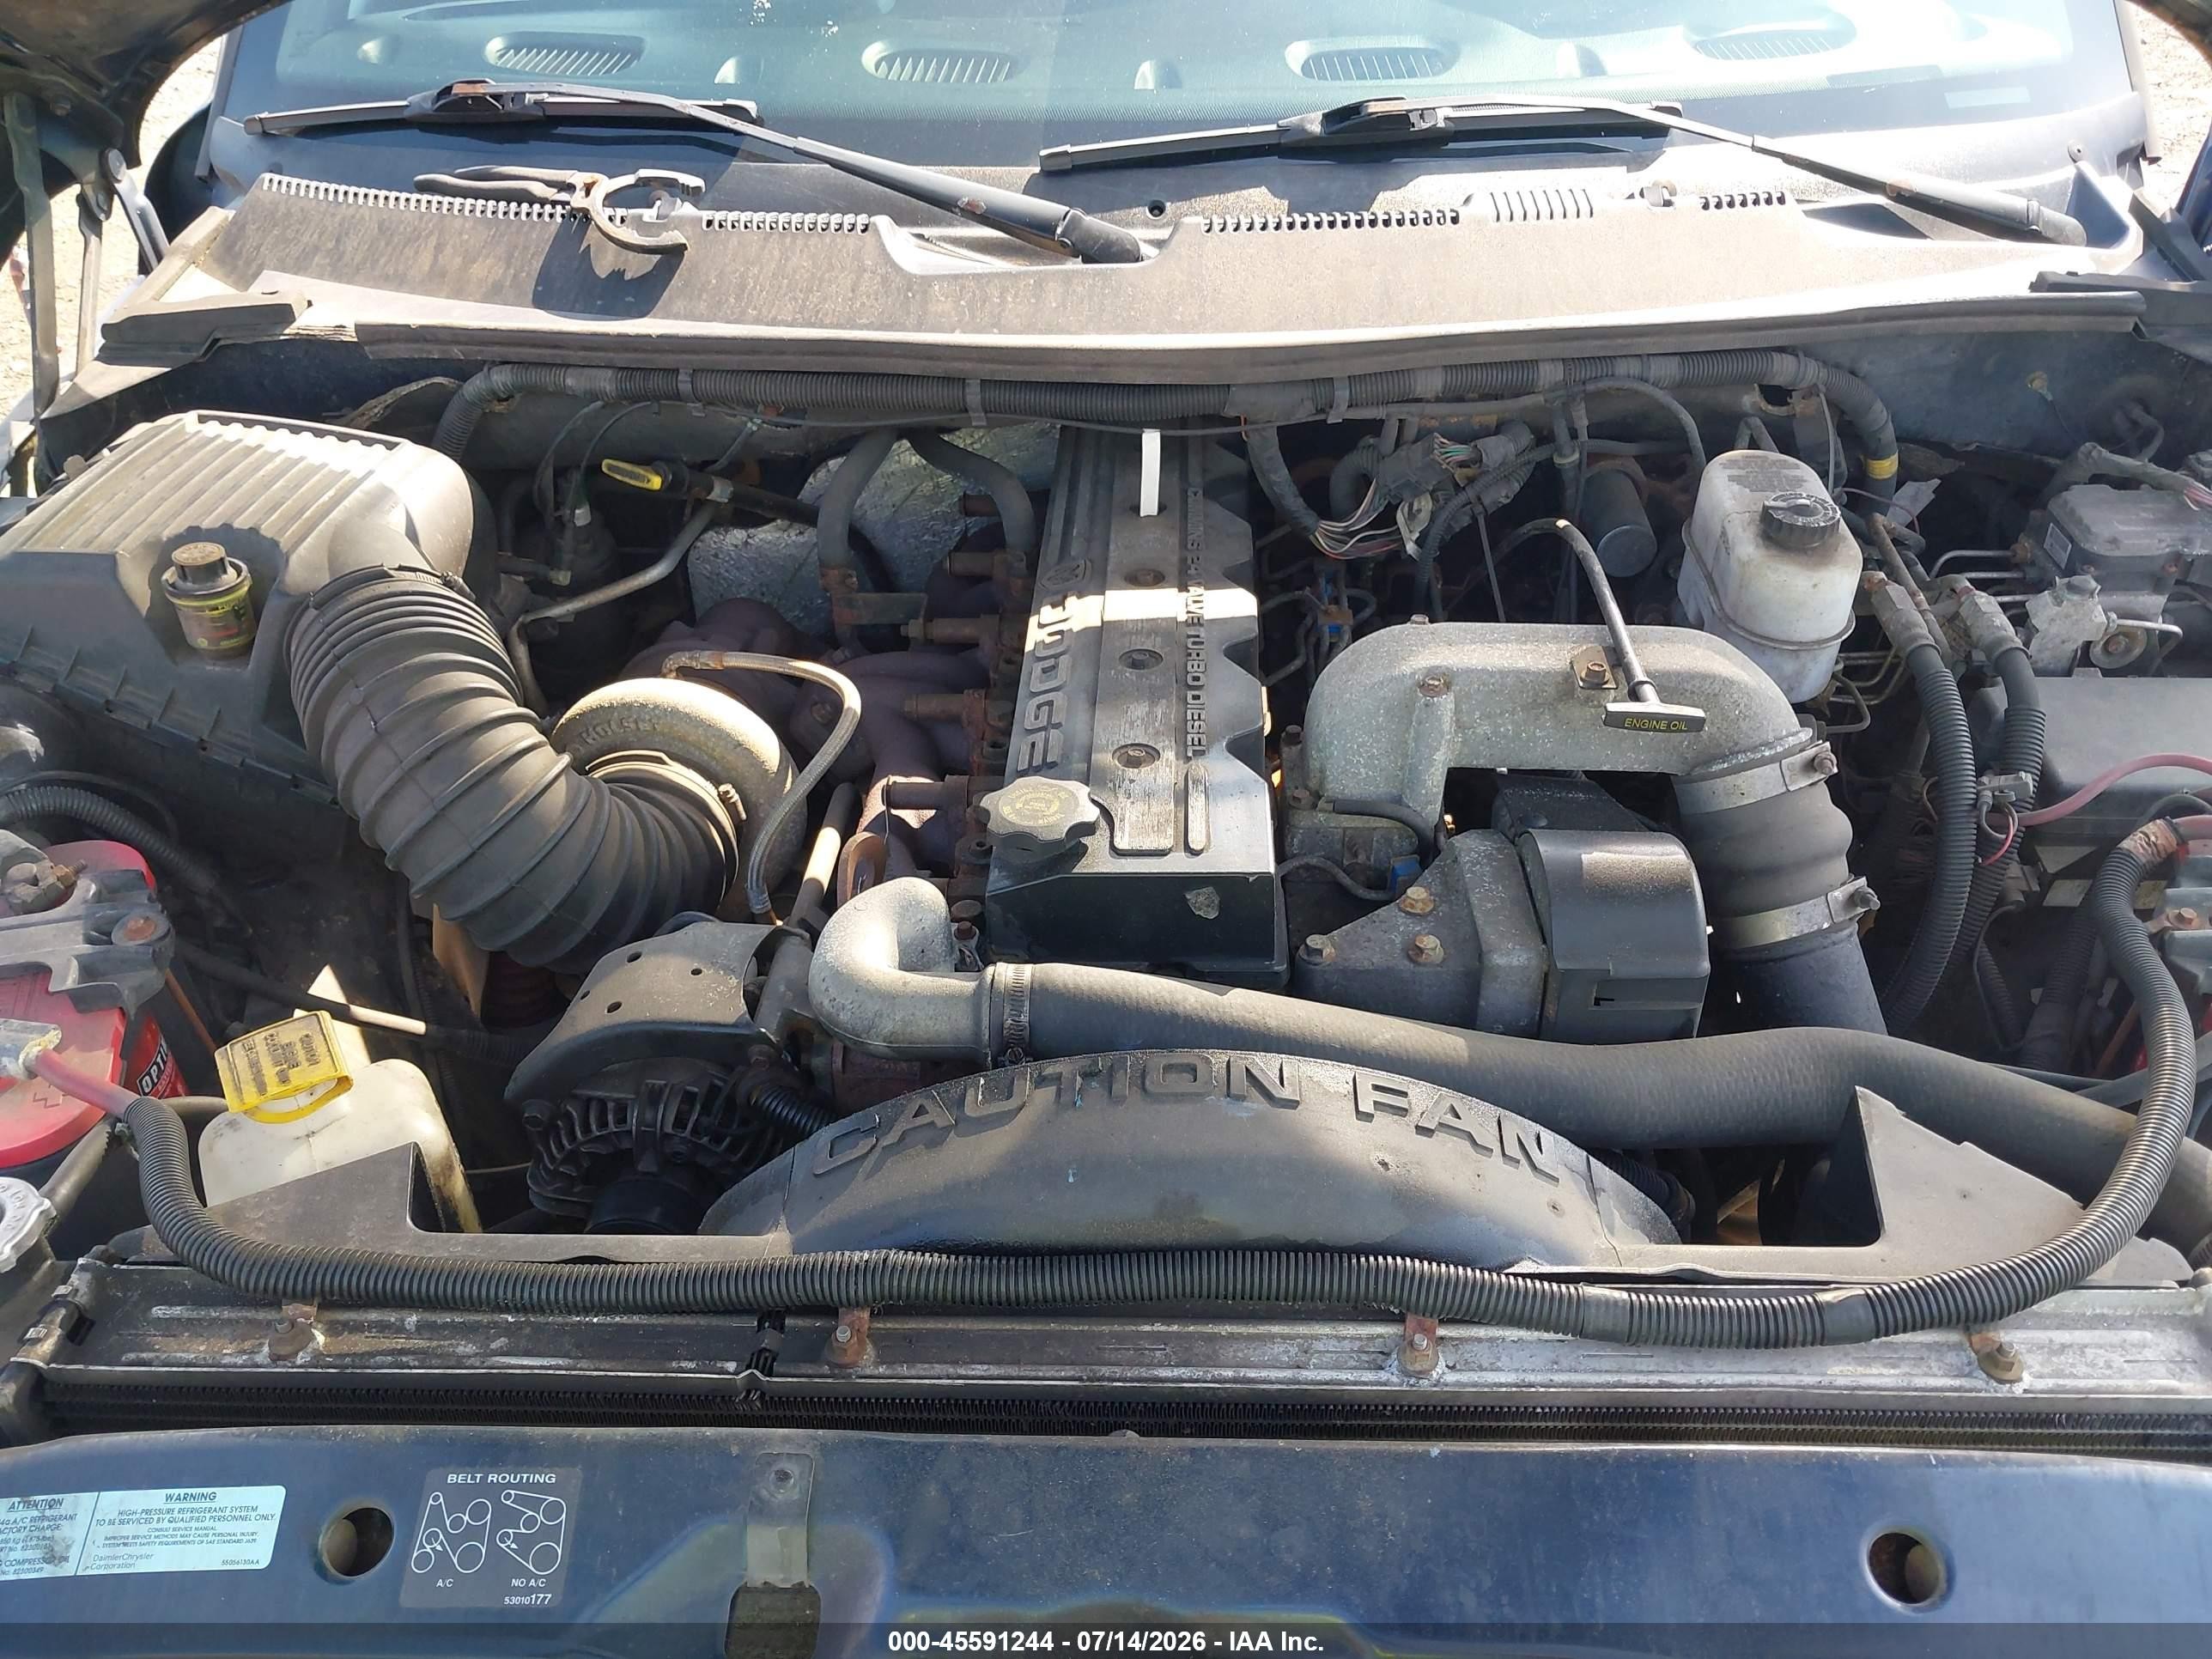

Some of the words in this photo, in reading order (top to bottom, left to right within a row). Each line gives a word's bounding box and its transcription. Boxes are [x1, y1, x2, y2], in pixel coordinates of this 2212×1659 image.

[1187, 579, 1205, 627] VALVE
[1187, 629, 1206, 686] TURBO
[1018, 592, 1079, 773] DODGE
[1187, 690, 1206, 757] DIESEL
[1625, 718, 1668, 730] ENGINE
[1670, 720, 1688, 730] OIL
[811, 1051, 1300, 1184] CAUTION
[1353, 1070, 1560, 1188] FAN
[447, 1474, 483, 1484] BELT
[487, 1474, 556, 1484] ROUTING
[165, 1491, 217, 1502] WARNING
[8, 1498, 64, 1510] ATTENTION
[118, 1507, 176, 1517] HIGH-PRESSURE
[177, 1505, 228, 1516] REFRIGERANT
[229, 1504, 258, 1514] SYSTEM
[11, 1516, 28, 1525] A/C
[29, 1513, 78, 1522] REFRIGERANT
[96, 1518, 106, 1527] TO
[118, 1516, 155, 1526] SERVICED
[167, 1515, 207, 1524] QUALIFIED
[209, 1514, 252, 1522] PERSONNEL
[4, 1555, 58, 1566] COMPRES
[93, 1552, 155, 1562] DaimlerChrysler
[90, 1562, 136, 1571] Corporation
[436, 1578, 454, 1588] A/C
[511, 1578, 526, 1588] NO
[528, 1578, 546, 1588] A/C
[503, 1593, 552, 1605] 53010177
